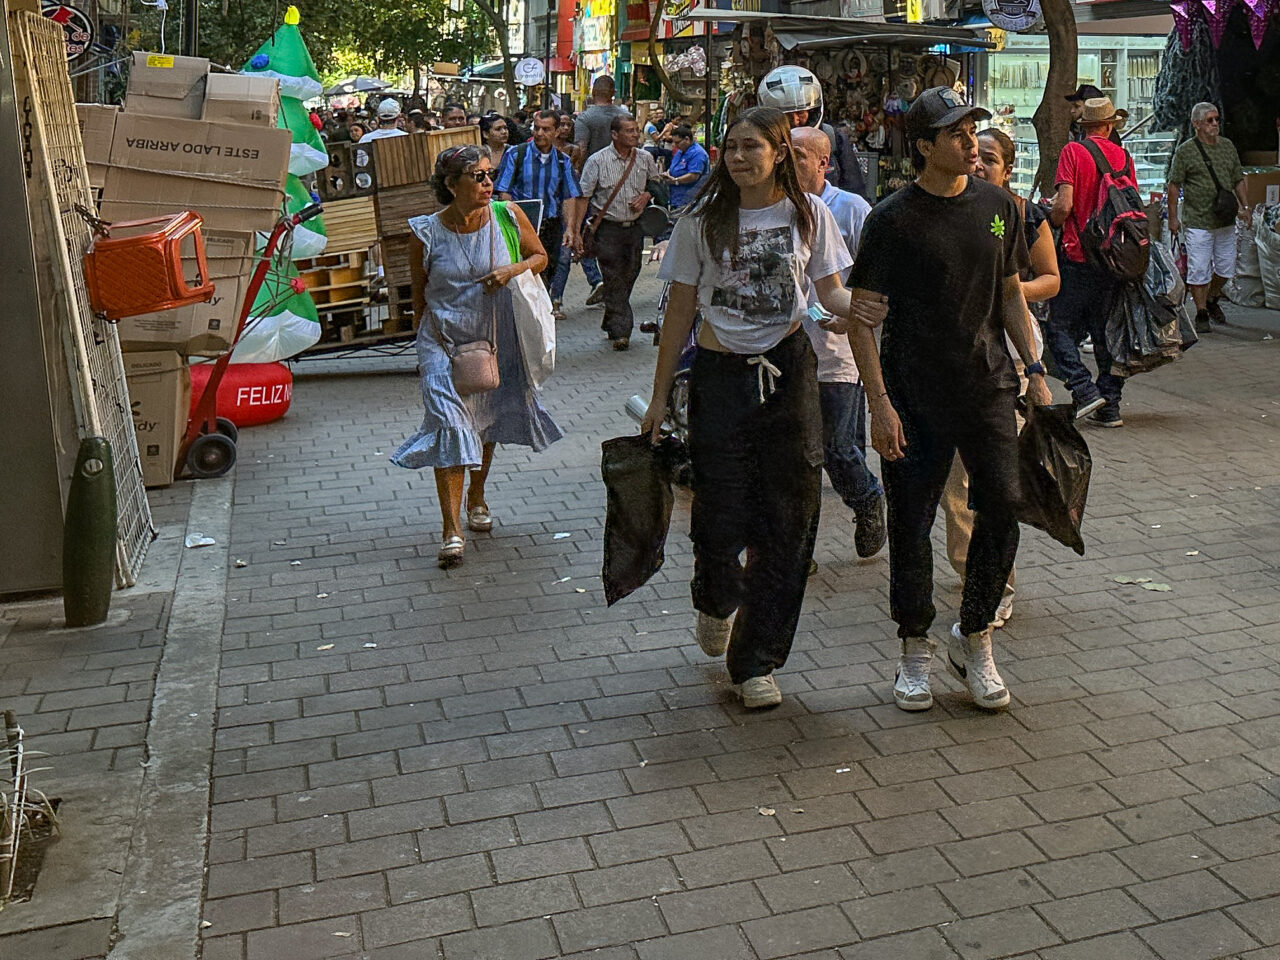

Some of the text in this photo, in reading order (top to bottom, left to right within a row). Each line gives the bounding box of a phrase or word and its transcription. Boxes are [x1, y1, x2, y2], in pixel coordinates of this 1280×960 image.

[126, 137, 260, 160] ESTE LADO ARRIBA
[236, 385, 282, 407] FELIZ
